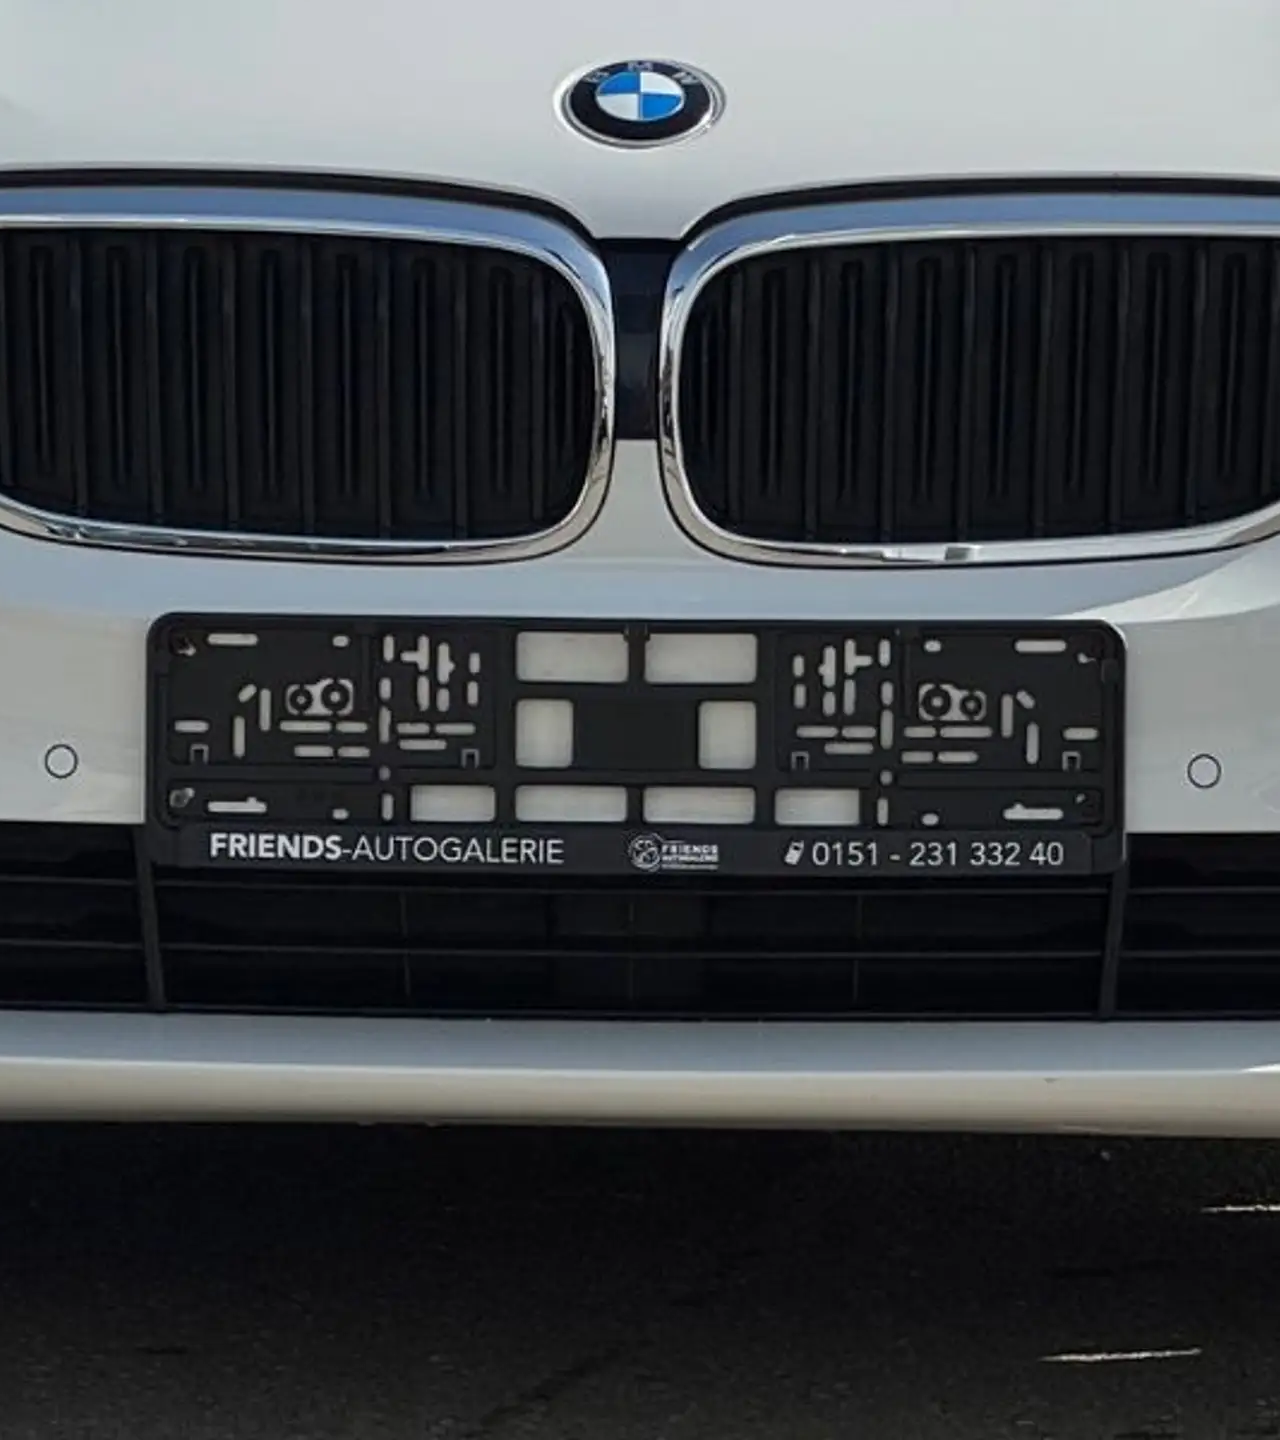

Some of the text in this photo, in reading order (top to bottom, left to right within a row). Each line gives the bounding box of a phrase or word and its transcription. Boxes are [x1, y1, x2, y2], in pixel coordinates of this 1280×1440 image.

[209, 832, 565, 864] FRIENDS-AUTOGALERIE
[812, 841, 878, 866] 0151
[909, 841, 958, 866] 231
[970, 841, 1020, 866] 332
[1029, 841, 1064, 866] 40
